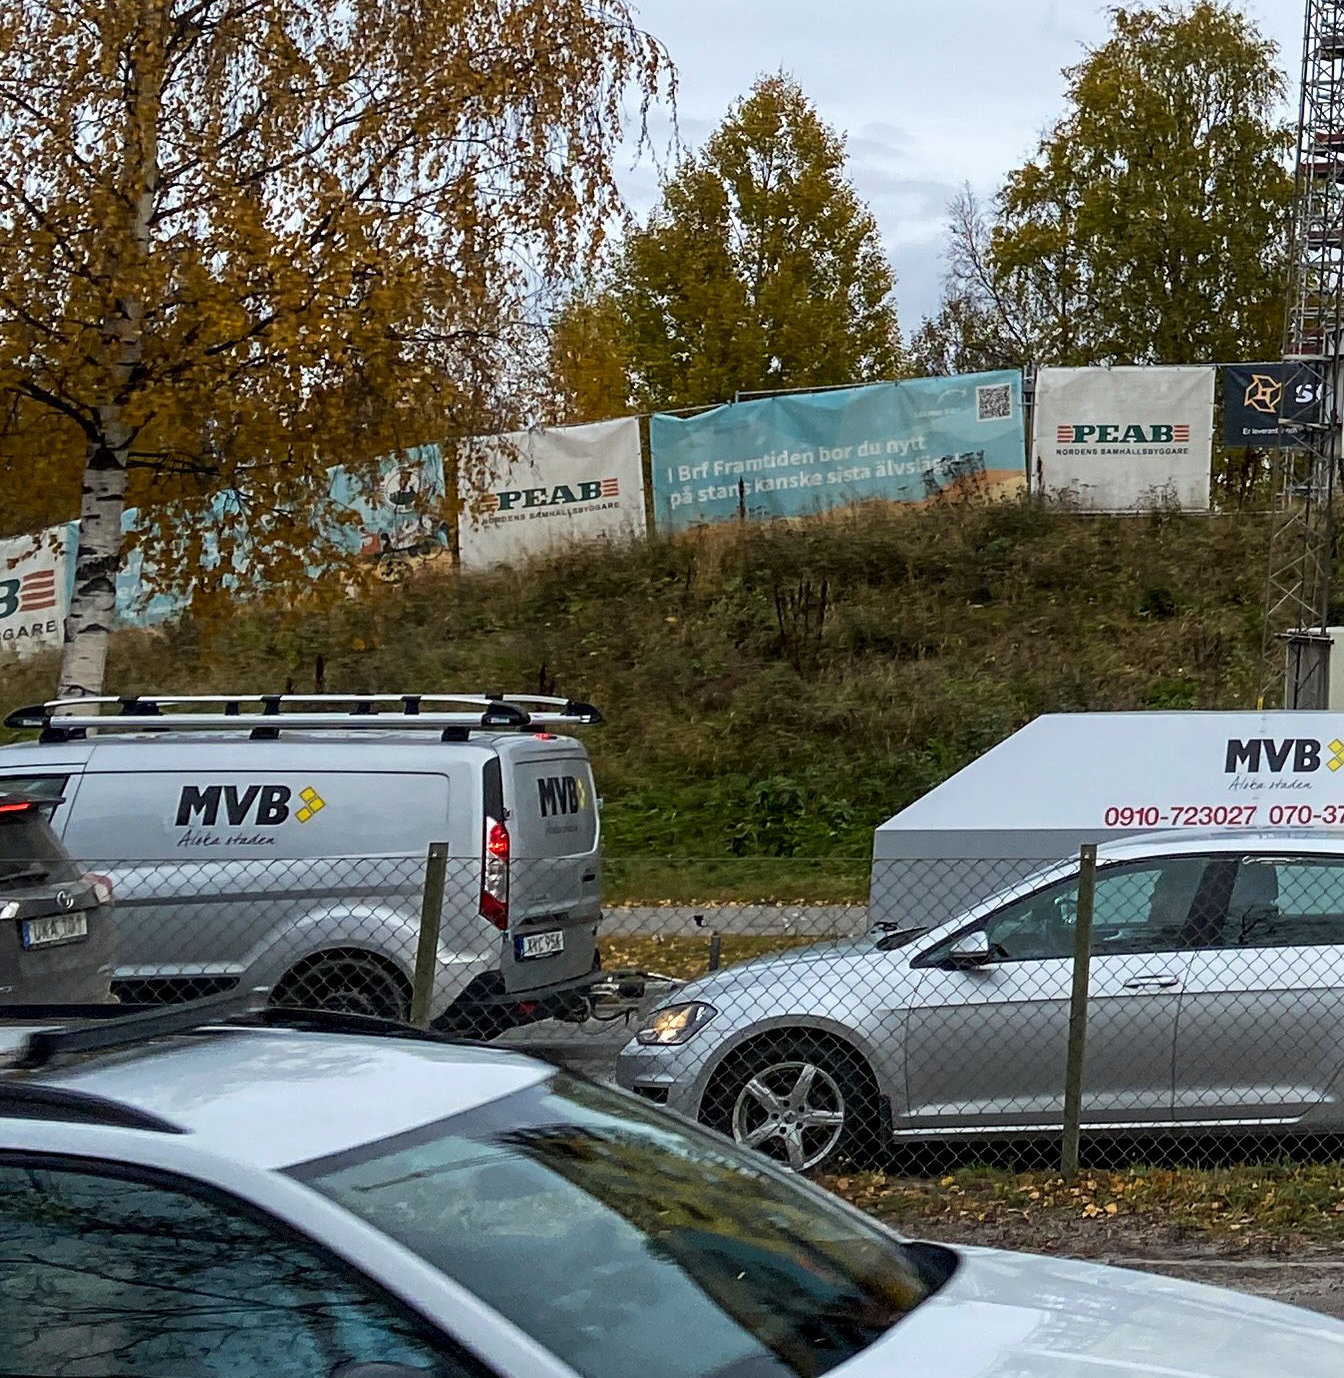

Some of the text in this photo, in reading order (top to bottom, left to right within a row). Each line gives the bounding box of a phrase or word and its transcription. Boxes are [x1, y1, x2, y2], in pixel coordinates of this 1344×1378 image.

[1070, 424, 1174, 444] PEAB
[678, 461, 709, 482] Brf
[713, 449, 815, 477] Framtiden
[819, 445, 852, 463] bor
[857, 440, 880, 458] du
[886, 435, 928, 457] nytt
[1056, 448, 1098, 456] NORDENS
[496, 480, 603, 511] PEAB
[670, 484, 693, 510] på
[754, 470, 823, 494] kanske
[826, 465, 871, 484] sista
[1224, 738, 1321, 773] MVB
[537, 775, 579, 818] MVB
[1268, 777, 1313, 790] staden
[174, 784, 292, 827] MVB
[1104, 805, 1258, 827] 0910-723027
